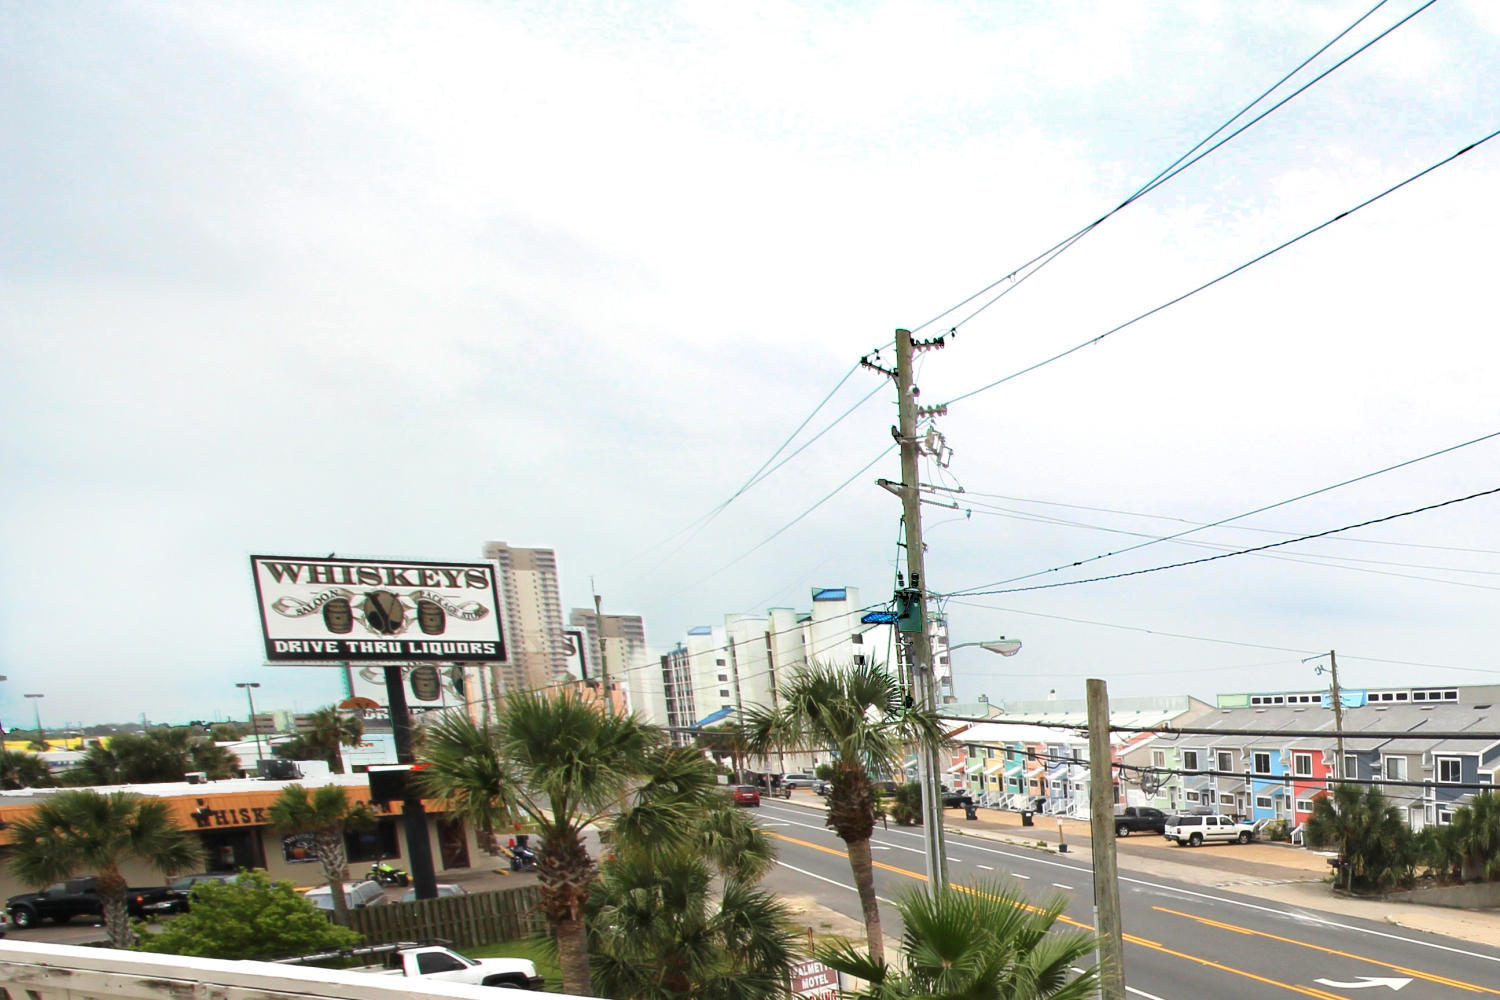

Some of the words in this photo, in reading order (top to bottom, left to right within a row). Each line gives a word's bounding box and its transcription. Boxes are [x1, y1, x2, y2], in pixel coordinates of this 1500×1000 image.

[261, 561, 489, 590] WHISKEYS
[296, 589, 338, 617] SALOON
[274, 640, 339, 654] DRIVE
[346, 640, 401, 655] THRU
[409, 641, 496, 656] LIQUORS
[801, 973, 829, 990] MOTEL
